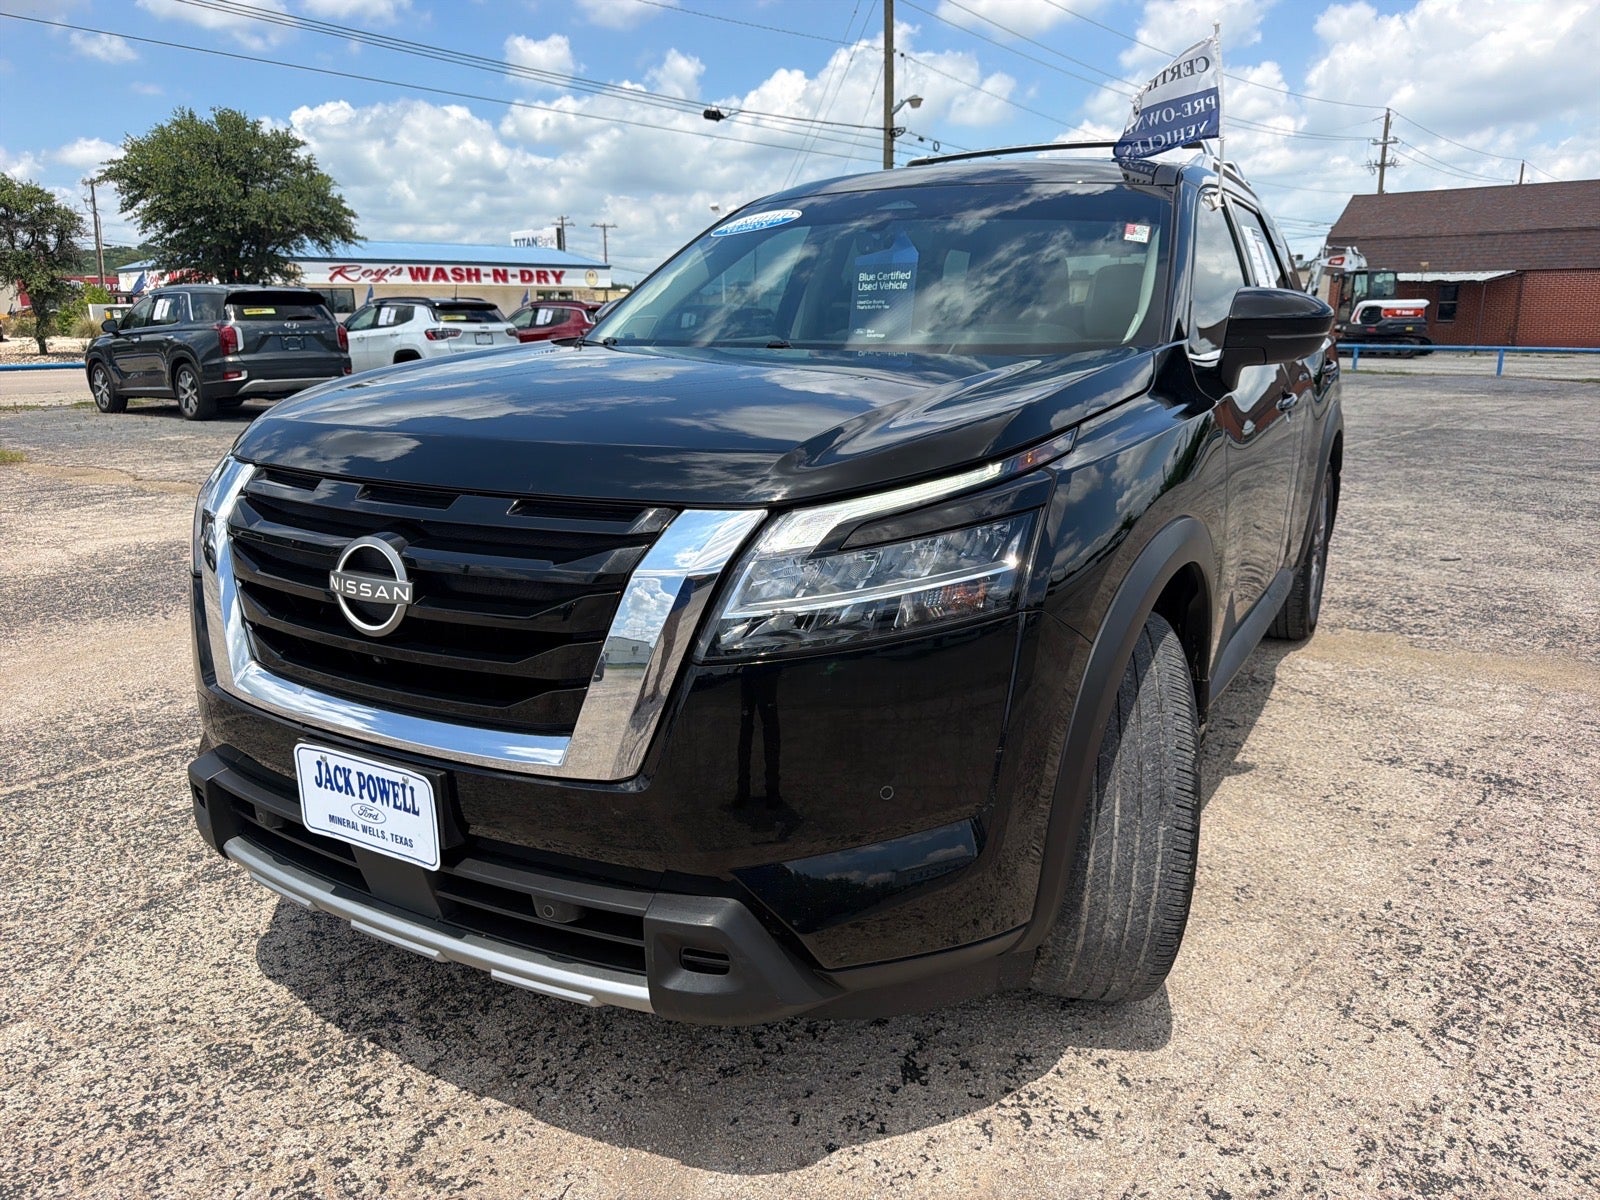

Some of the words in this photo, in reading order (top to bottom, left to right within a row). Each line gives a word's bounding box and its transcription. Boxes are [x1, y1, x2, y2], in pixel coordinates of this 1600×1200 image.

[328, 264, 403, 283] Roy's
[407, 266, 566, 284] WASH-N-DRY
[858, 272, 876, 281] Blue
[877, 270, 911, 280] Certified
[857, 282, 878, 291] Used
[879, 280, 908, 290] Vehicle
[330, 575, 410, 601] NISSAN
[314, 759, 356, 797] JACK
[356, 771, 420, 817] POWELL
[357, 806, 380, 821] Ford
[328, 814, 360, 832] MINERAL
[361, 825, 389, 842] WELLS,
[390, 833, 414, 848] TEXAS
